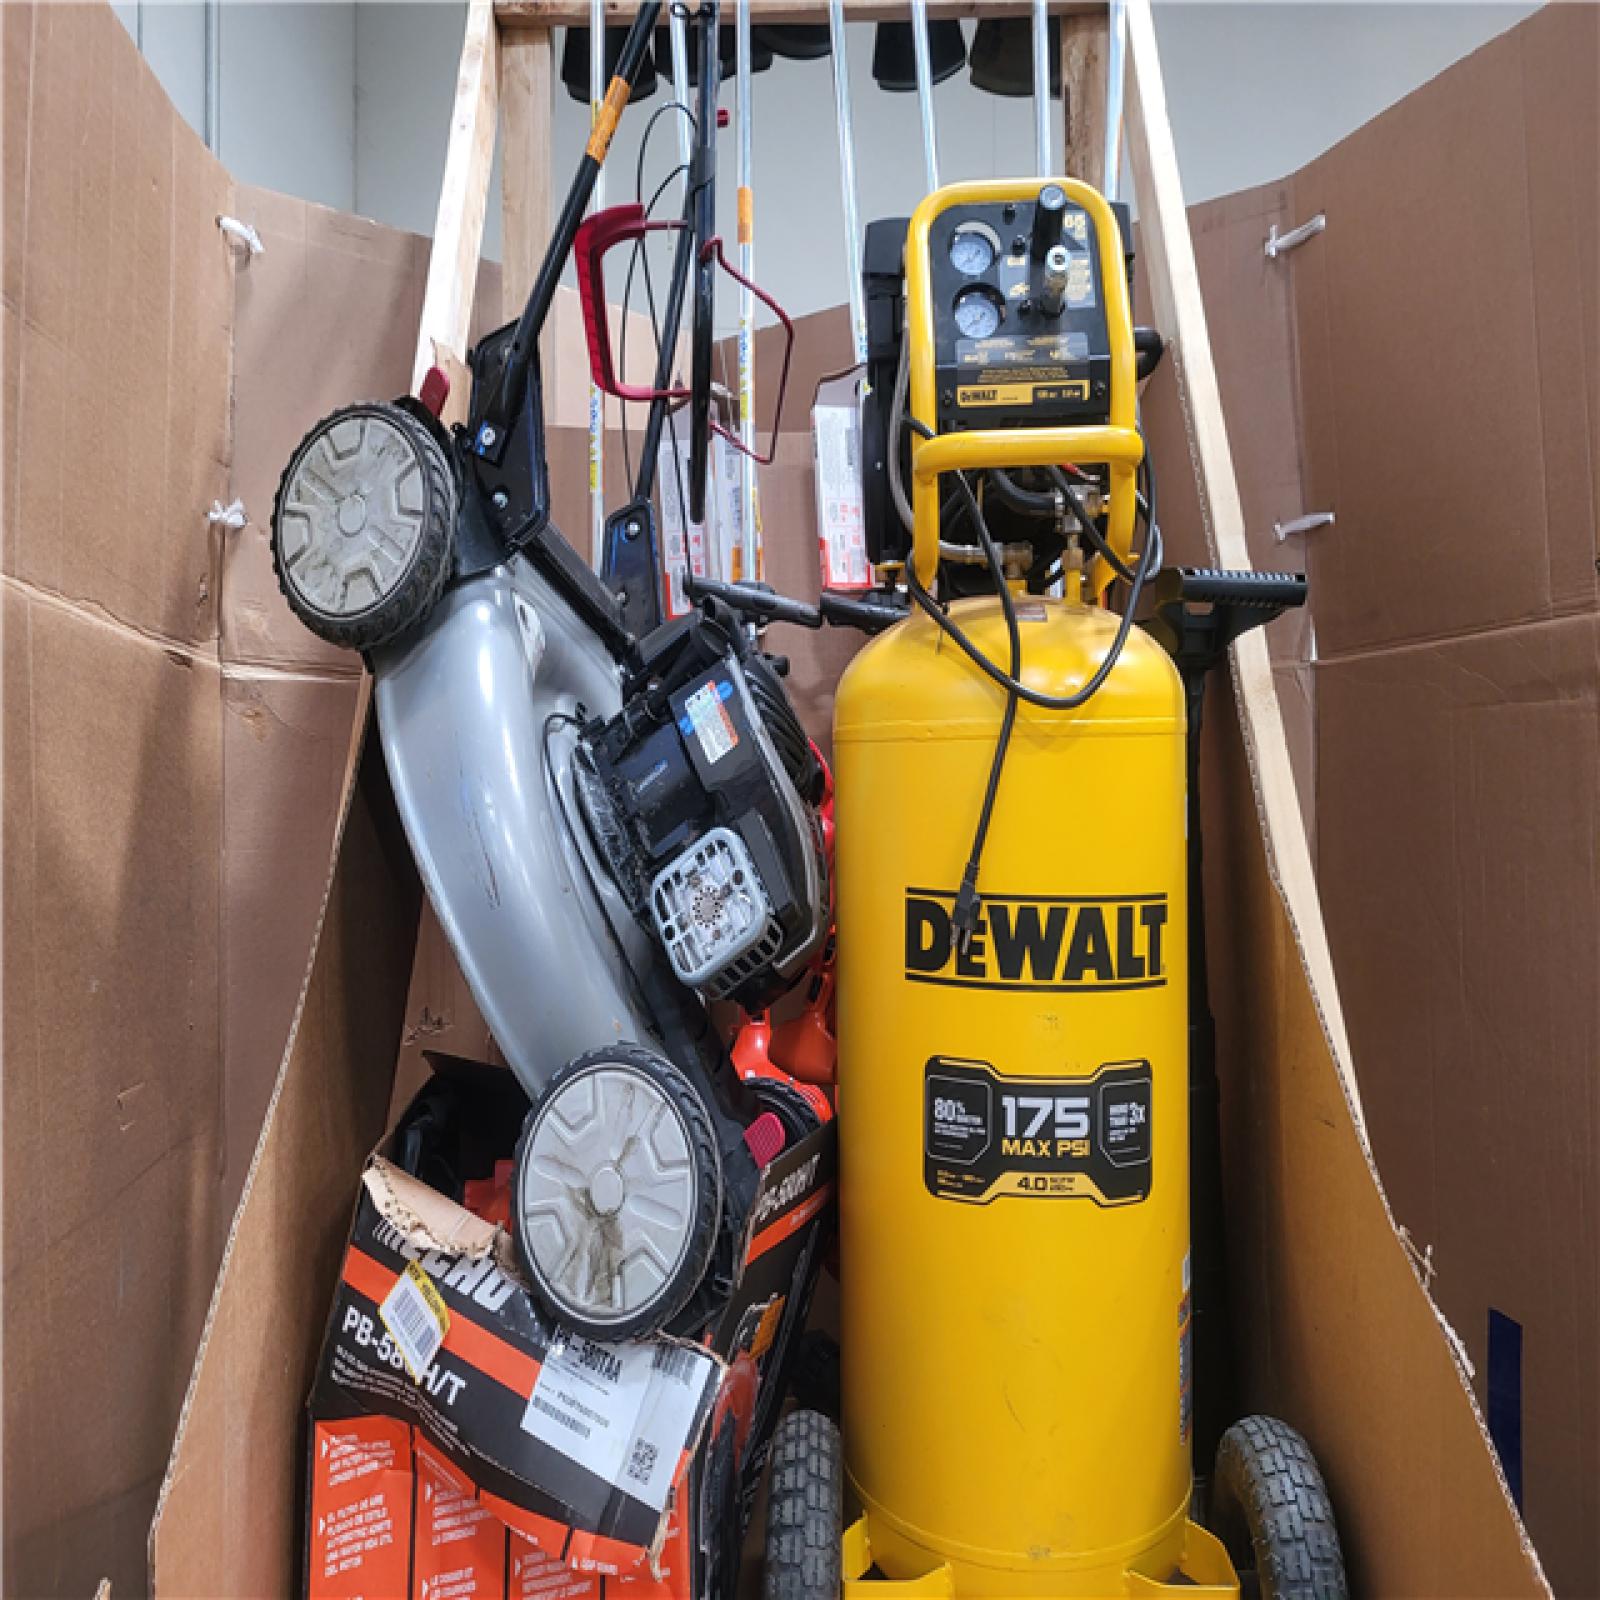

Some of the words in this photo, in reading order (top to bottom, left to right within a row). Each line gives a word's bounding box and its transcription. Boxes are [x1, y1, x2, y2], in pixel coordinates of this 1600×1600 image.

[1001, 1096, 1091, 1139] 175
[1001, 1139, 1051, 1157] MAX
[1056, 1139, 1091, 1157] PSI
[1016, 1176, 1049, 1191] 4.0
